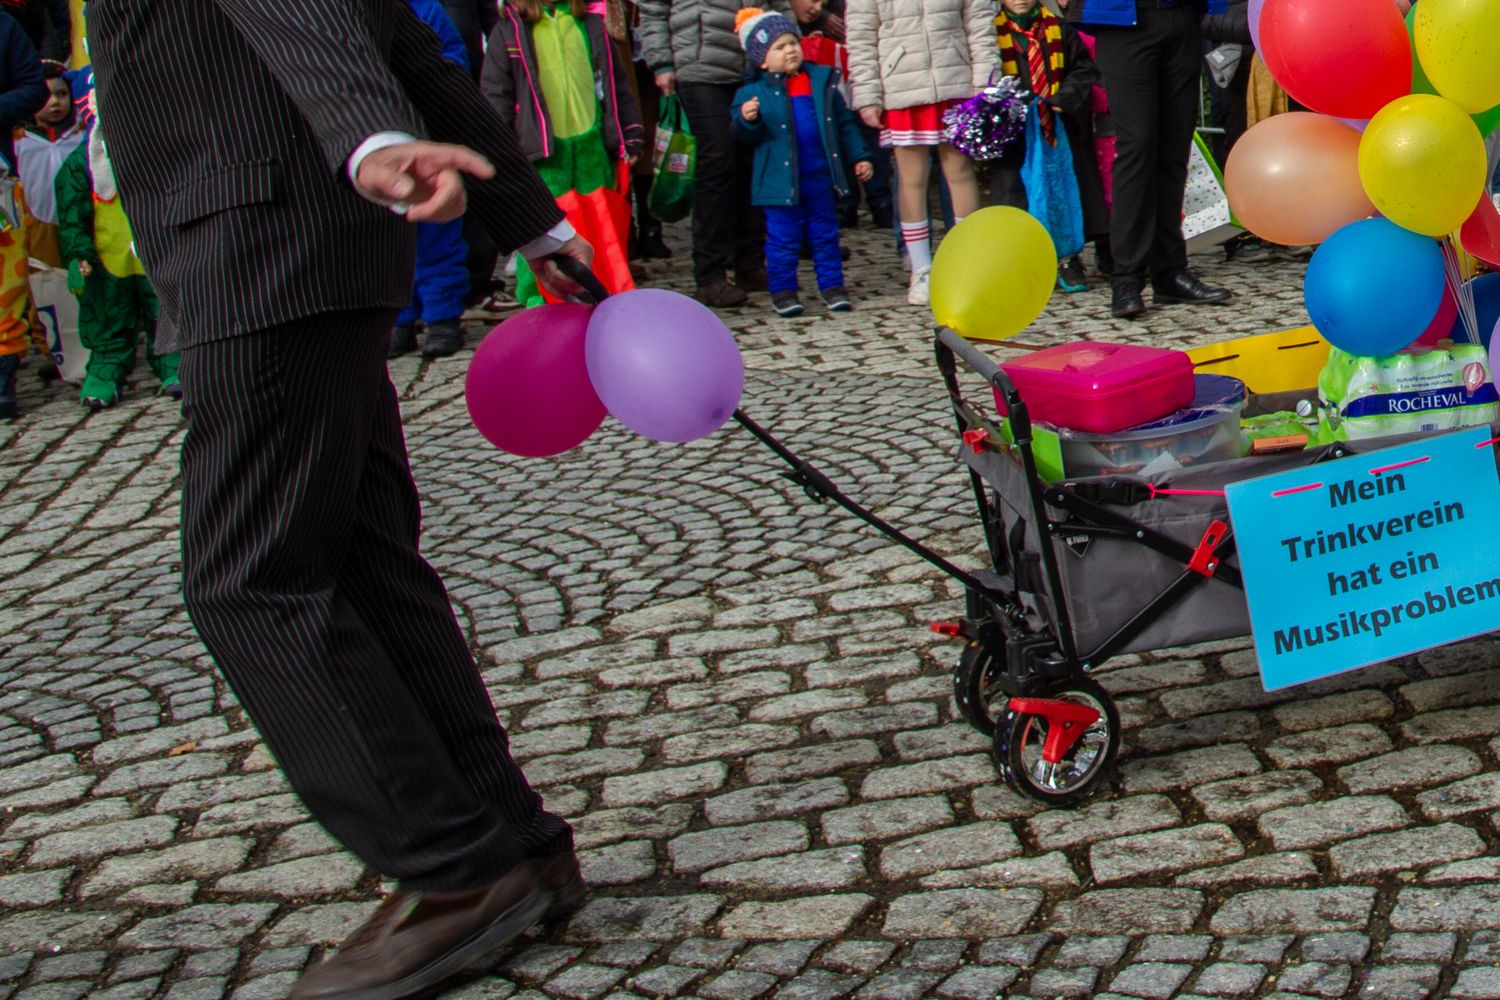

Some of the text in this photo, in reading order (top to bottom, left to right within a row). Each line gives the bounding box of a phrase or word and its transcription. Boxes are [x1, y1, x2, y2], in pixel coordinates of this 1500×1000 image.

[1388, 392, 1466, 413] ROCHEVAL
[1329, 473, 1406, 508] Mein
[1281, 500, 1465, 562] Trinkverein
[1327, 551, 1440, 596] hat ein
